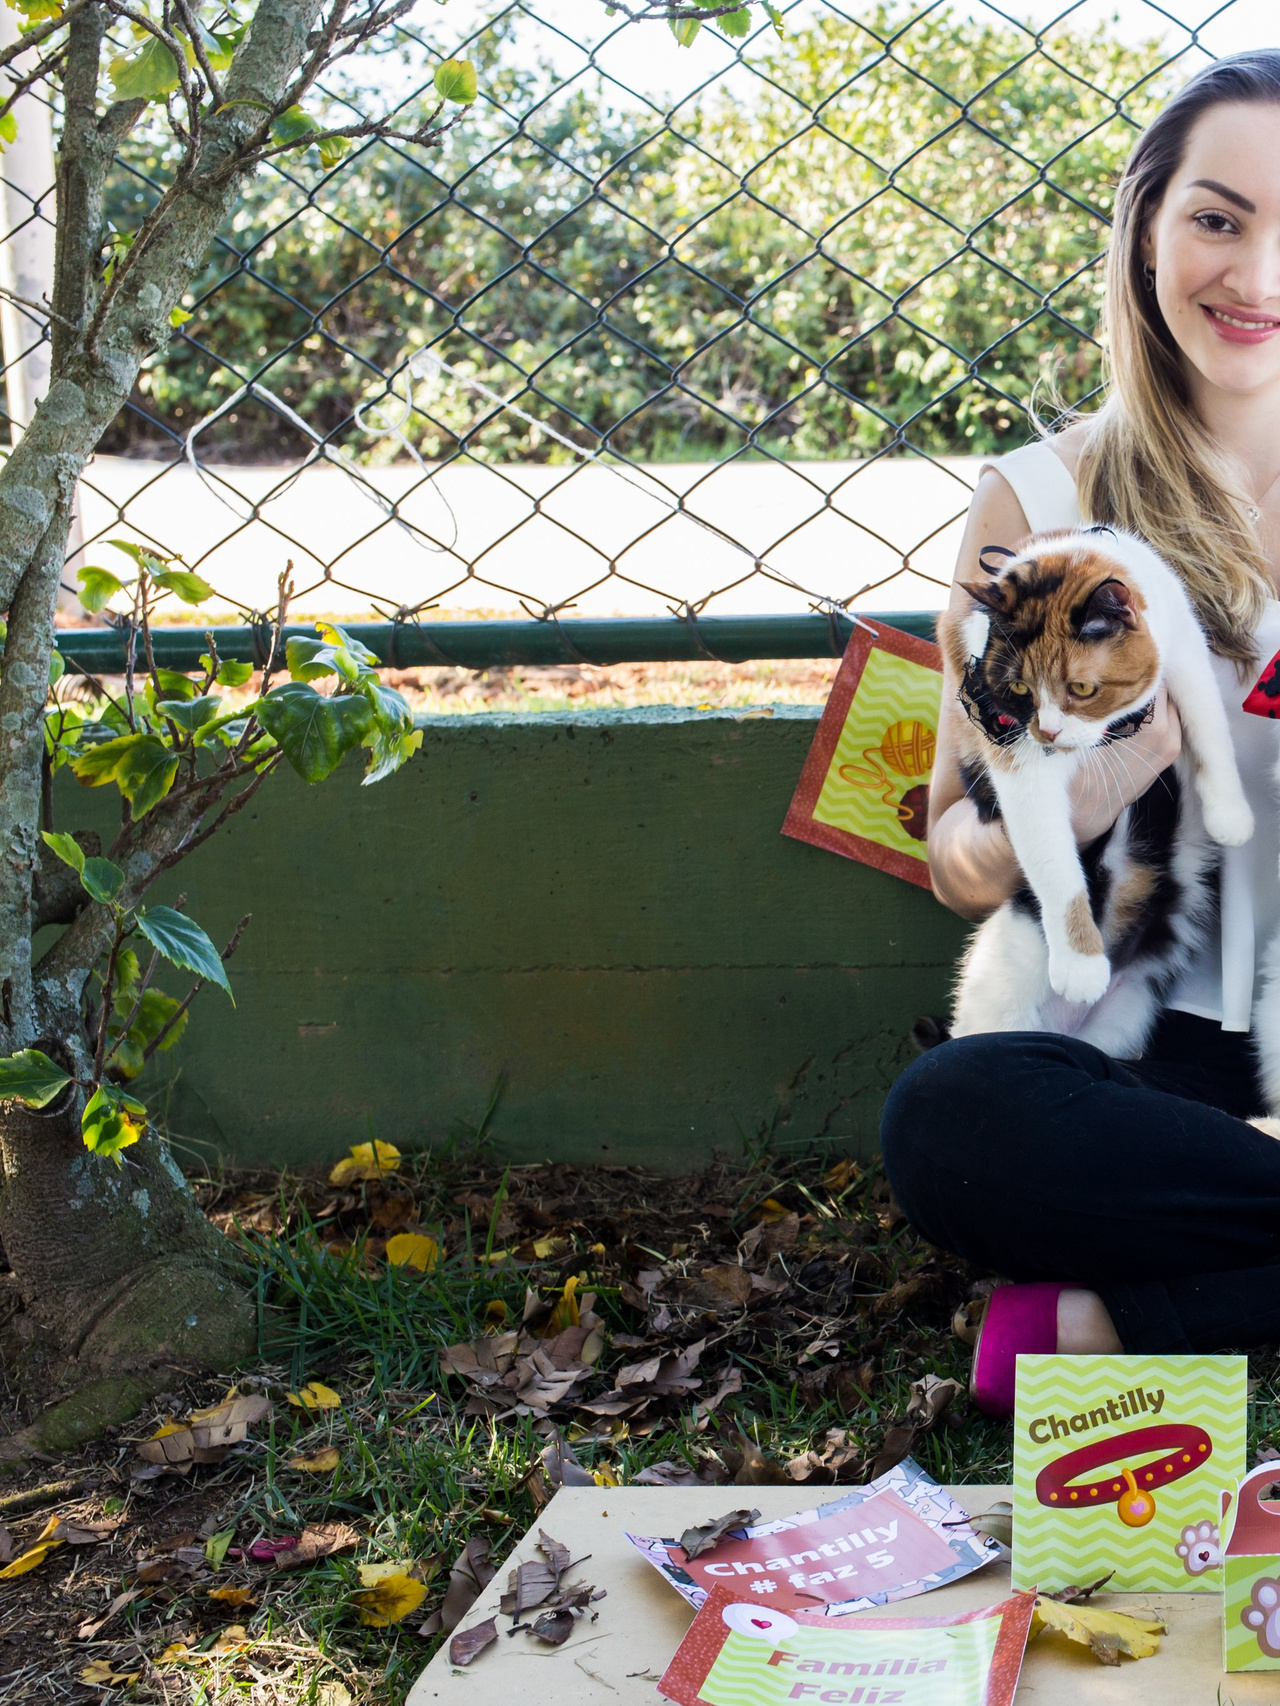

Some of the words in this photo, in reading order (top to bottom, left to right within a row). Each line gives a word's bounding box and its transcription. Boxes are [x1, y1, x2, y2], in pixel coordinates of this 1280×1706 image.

[1028, 1387, 1165, 1444] Chantilly
[703, 1518, 899, 1577] Chantilly
[749, 1578, 778, 1594] #
[788, 1563, 859, 1589] faz
[865, 1548, 896, 1570] 5
[788, 1682, 907, 1704] Feliz
